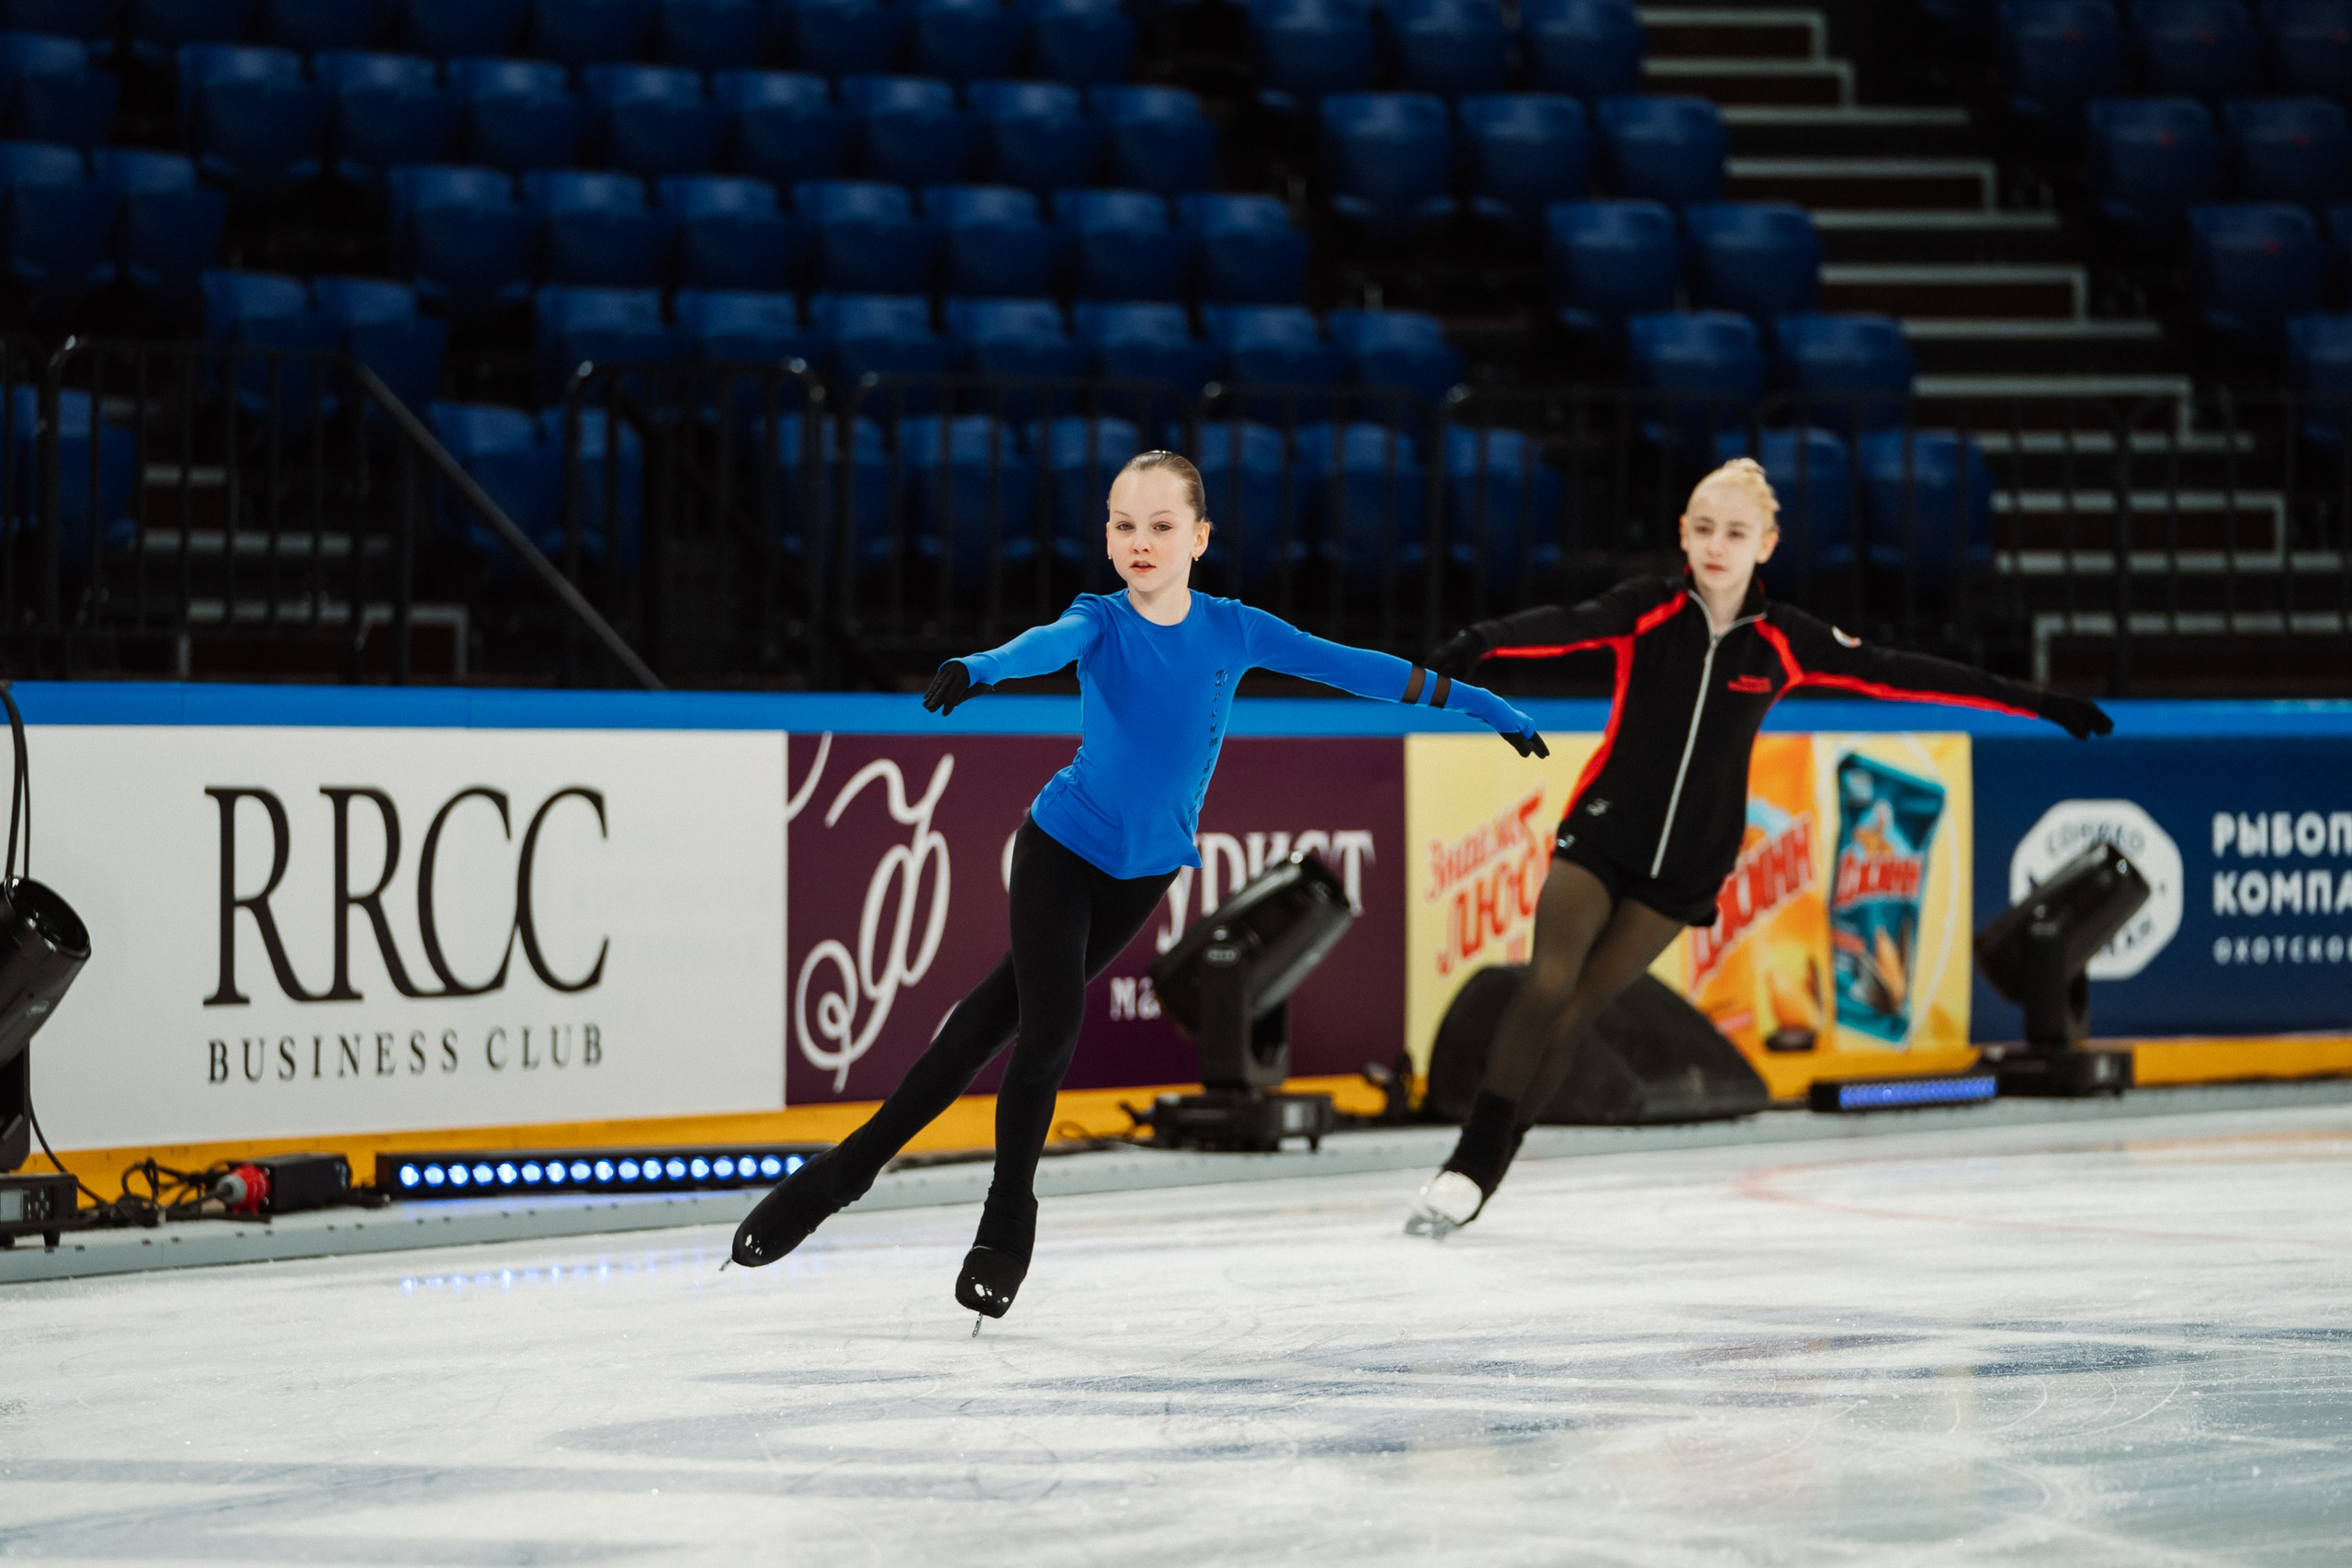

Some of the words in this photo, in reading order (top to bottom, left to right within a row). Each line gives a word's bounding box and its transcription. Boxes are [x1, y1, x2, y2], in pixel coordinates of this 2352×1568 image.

[202, 785, 610, 1007] RRCC
[2212, 934, 2352, 964] ОХОТСКО
[208, 1028, 458, 1085] BUSINESS
[485, 1022, 603, 1072] CLUB
